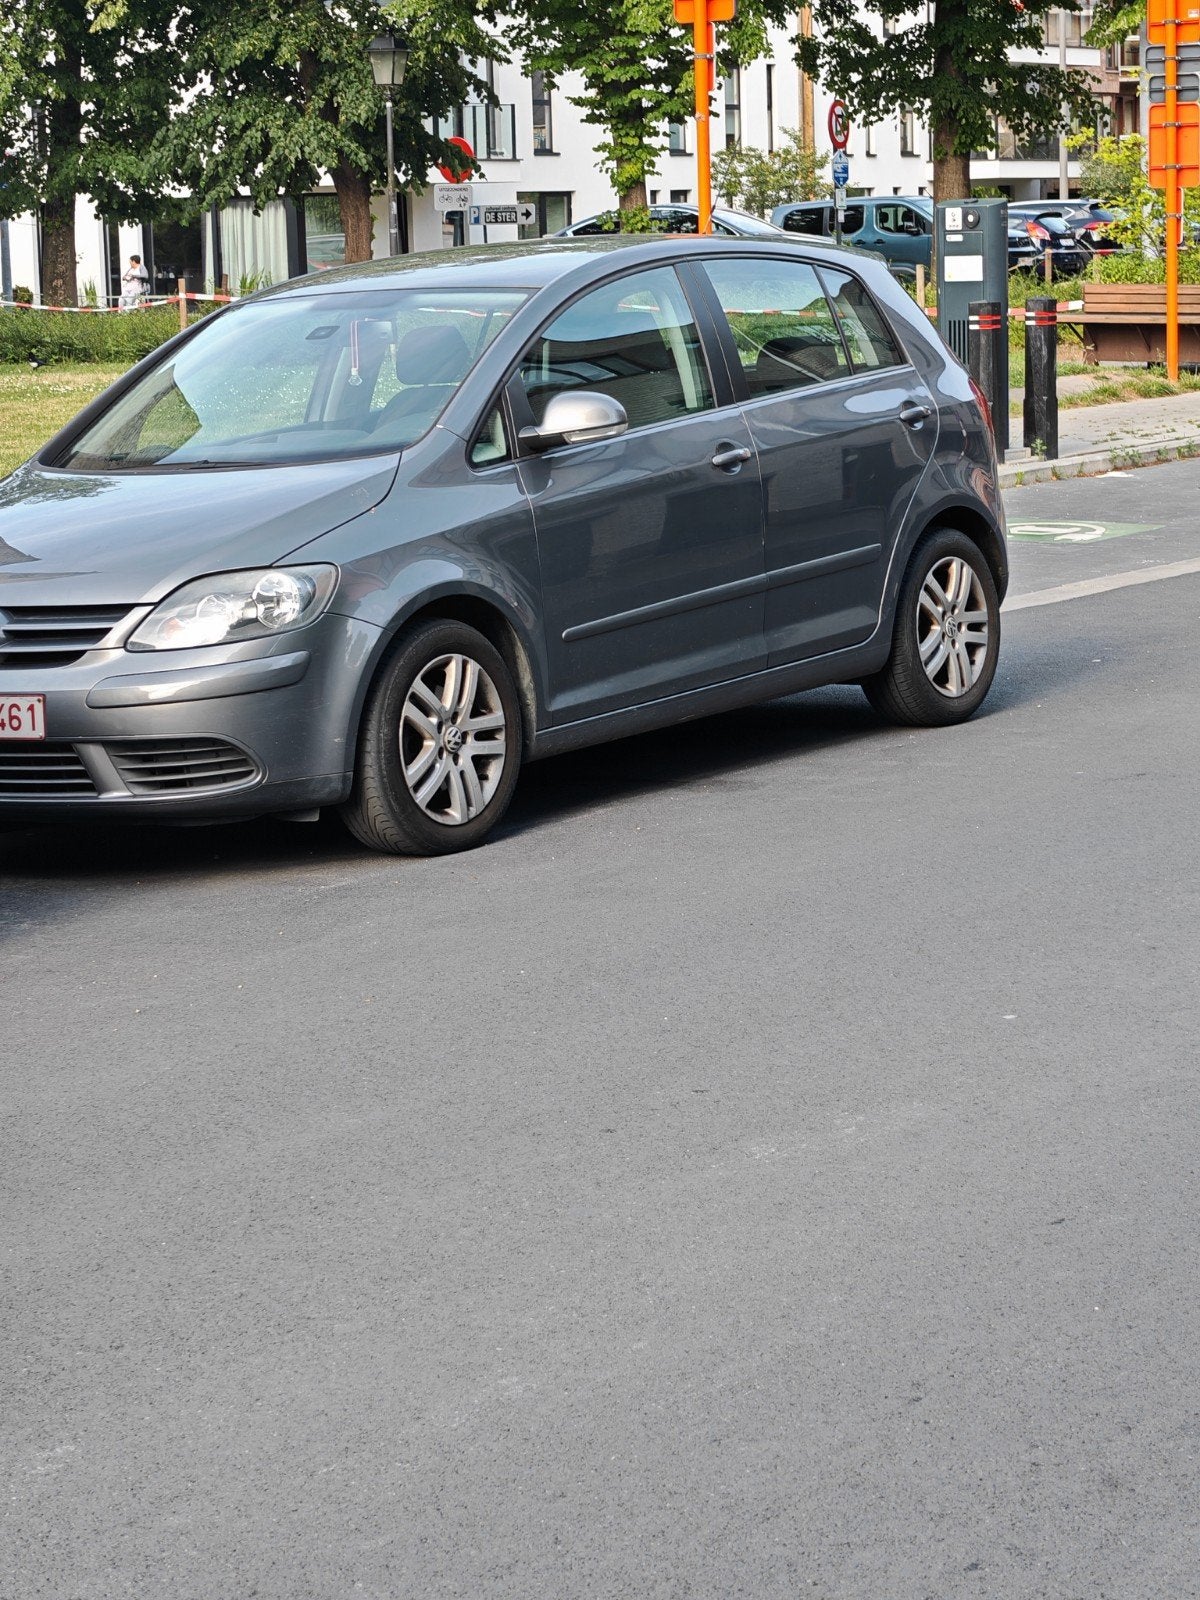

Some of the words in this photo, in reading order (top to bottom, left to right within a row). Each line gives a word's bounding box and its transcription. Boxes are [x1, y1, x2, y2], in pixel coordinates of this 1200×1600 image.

[470, 207, 479, 224] P
[485, 213, 496, 223] DE
[497, 212, 517, 223] STER
